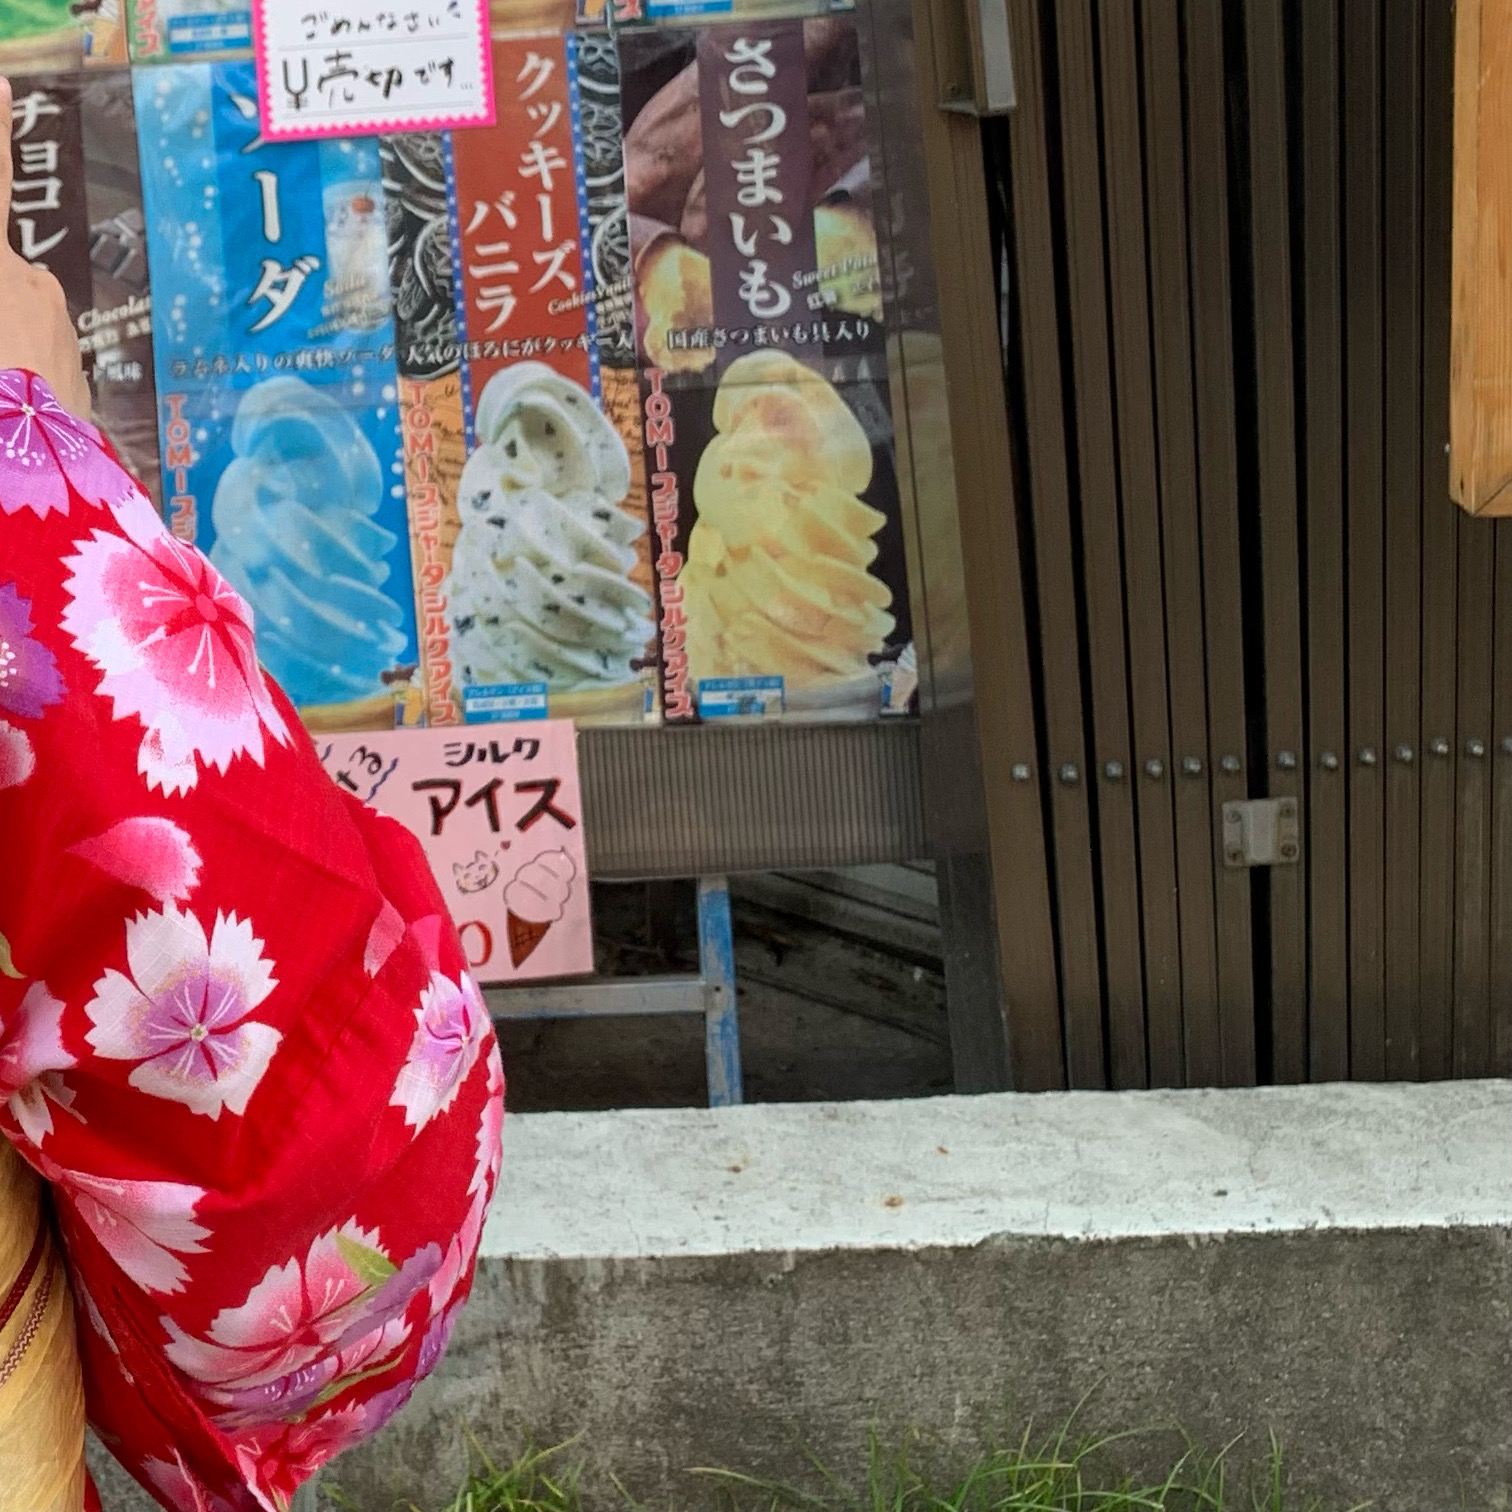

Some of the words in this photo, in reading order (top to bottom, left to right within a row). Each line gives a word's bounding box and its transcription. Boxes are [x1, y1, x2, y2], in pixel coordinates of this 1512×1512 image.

[10, 90, 70, 268] チョコレ
[517, 51, 579, 294] クッキーズ
[719, 37, 793, 319] さつまいも
[464, 190, 519, 334] バニラ
[411, 777, 576, 837] アイス
[444, 737, 540, 768] シルク
